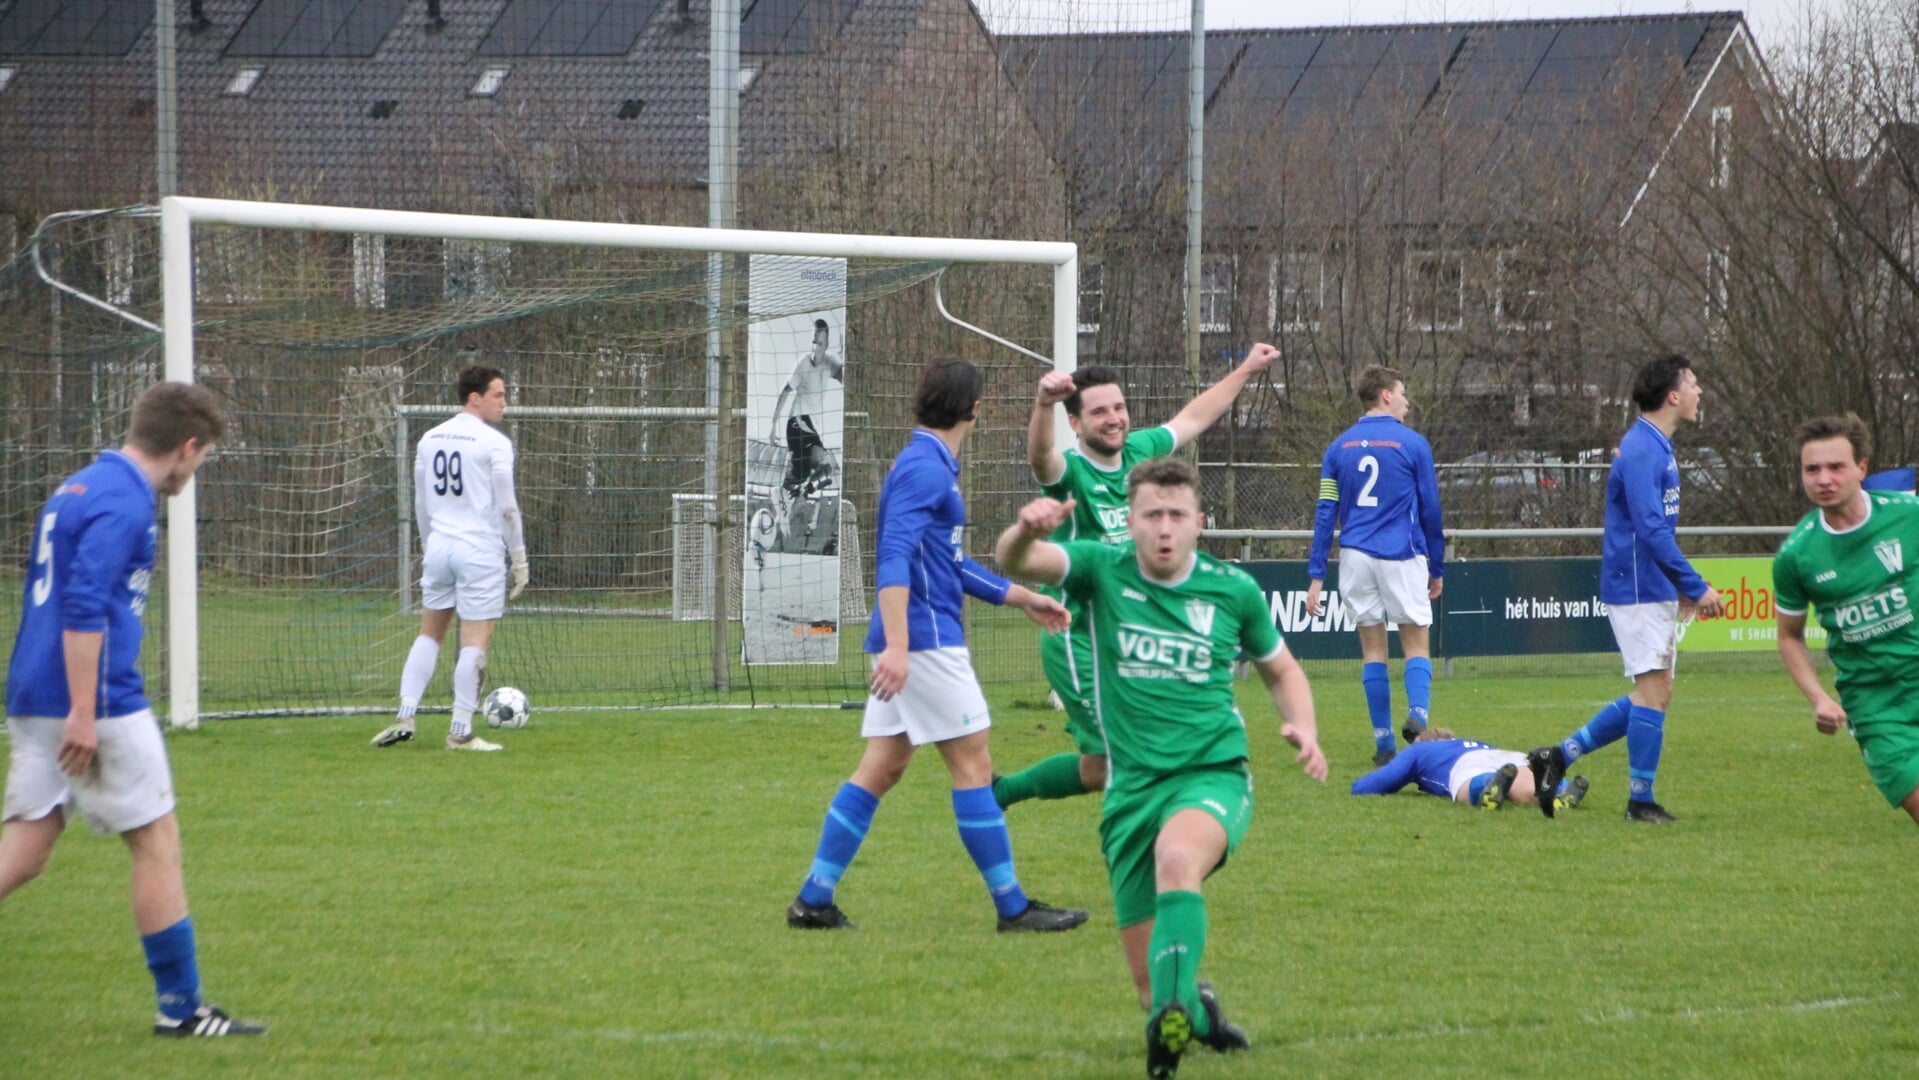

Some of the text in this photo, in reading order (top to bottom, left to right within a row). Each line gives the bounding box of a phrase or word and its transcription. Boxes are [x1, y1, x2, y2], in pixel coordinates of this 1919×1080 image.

[433, 449, 463, 497] 99
[1356, 455, 1379, 507] 2
[32, 511, 58, 607] 5
[1505, 595, 1609, 619] hét huis van ke
[1835, 587, 1908, 628] VOETS
[1117, 631, 1213, 671] VOETS
[1730, 627, 1744, 641] WE
